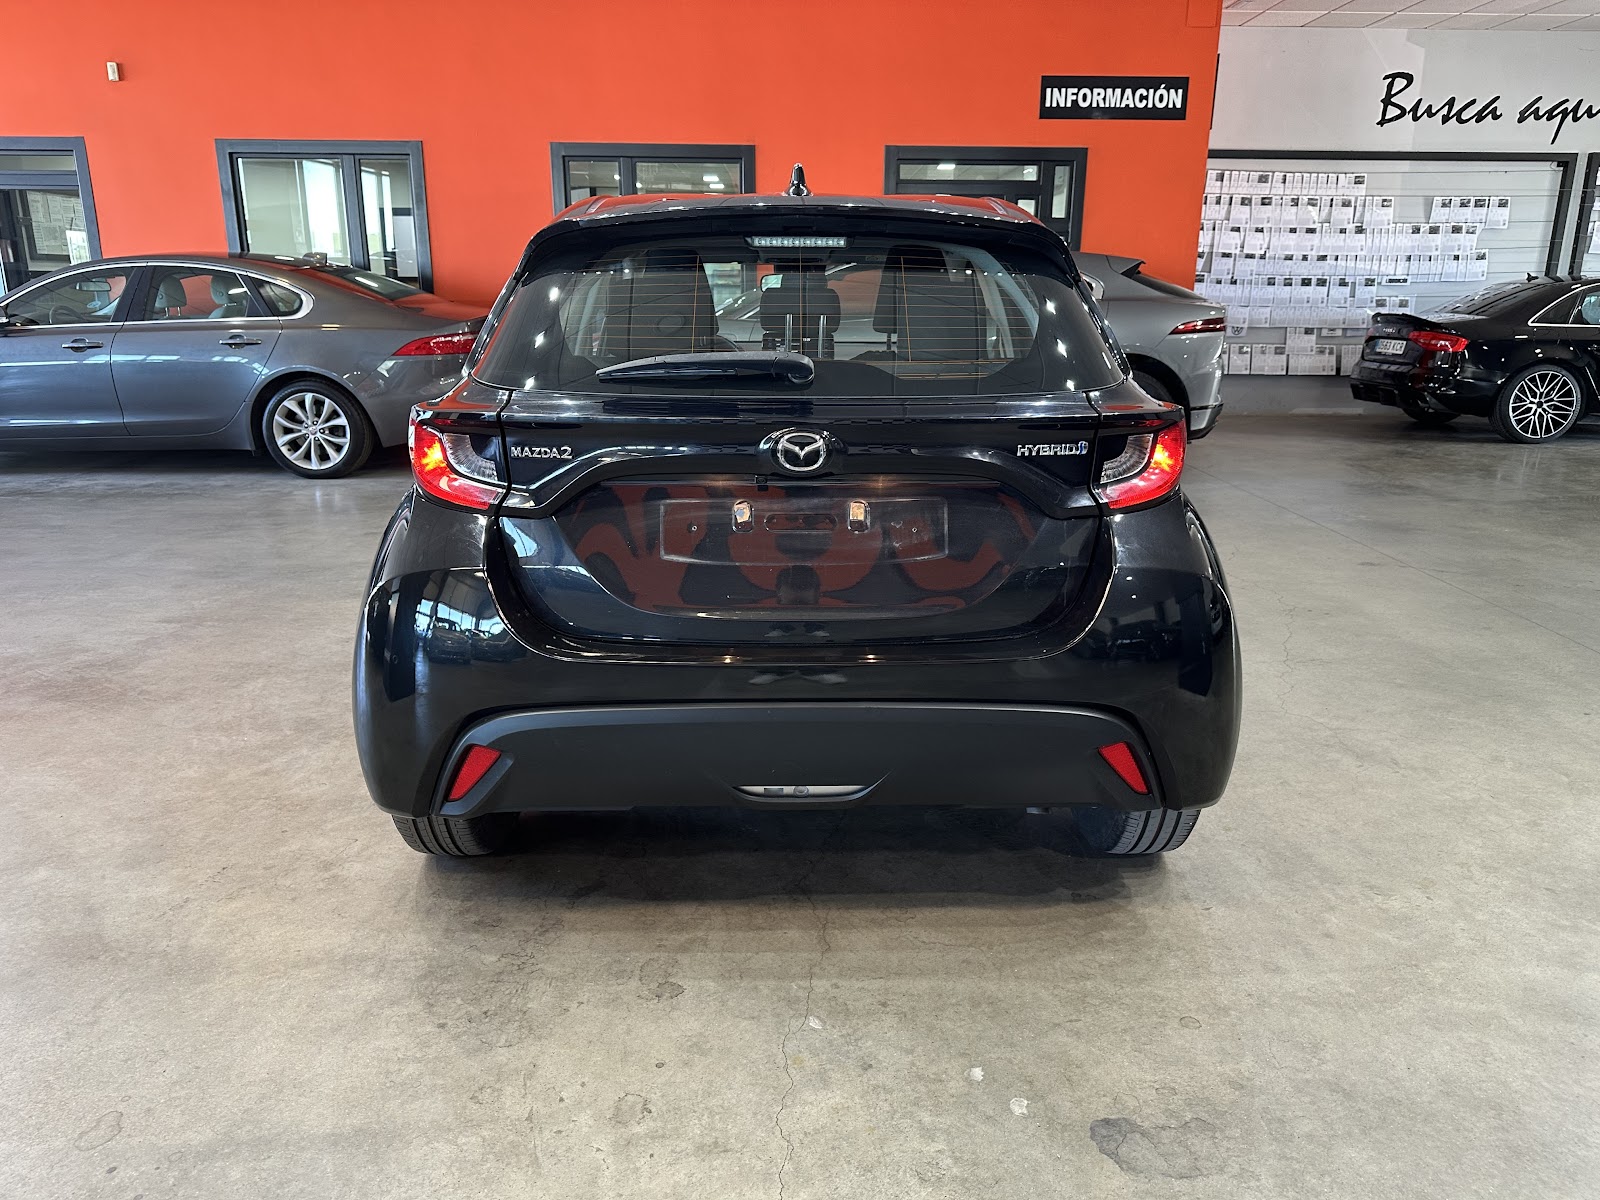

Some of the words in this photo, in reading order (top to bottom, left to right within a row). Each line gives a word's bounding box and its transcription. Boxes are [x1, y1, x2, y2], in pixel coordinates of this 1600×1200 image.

[1045, 84, 1184, 109] INFORMACIÓN
[1376, 71, 1503, 127] Busca
[1016, 444, 1078, 457] HYBRID
